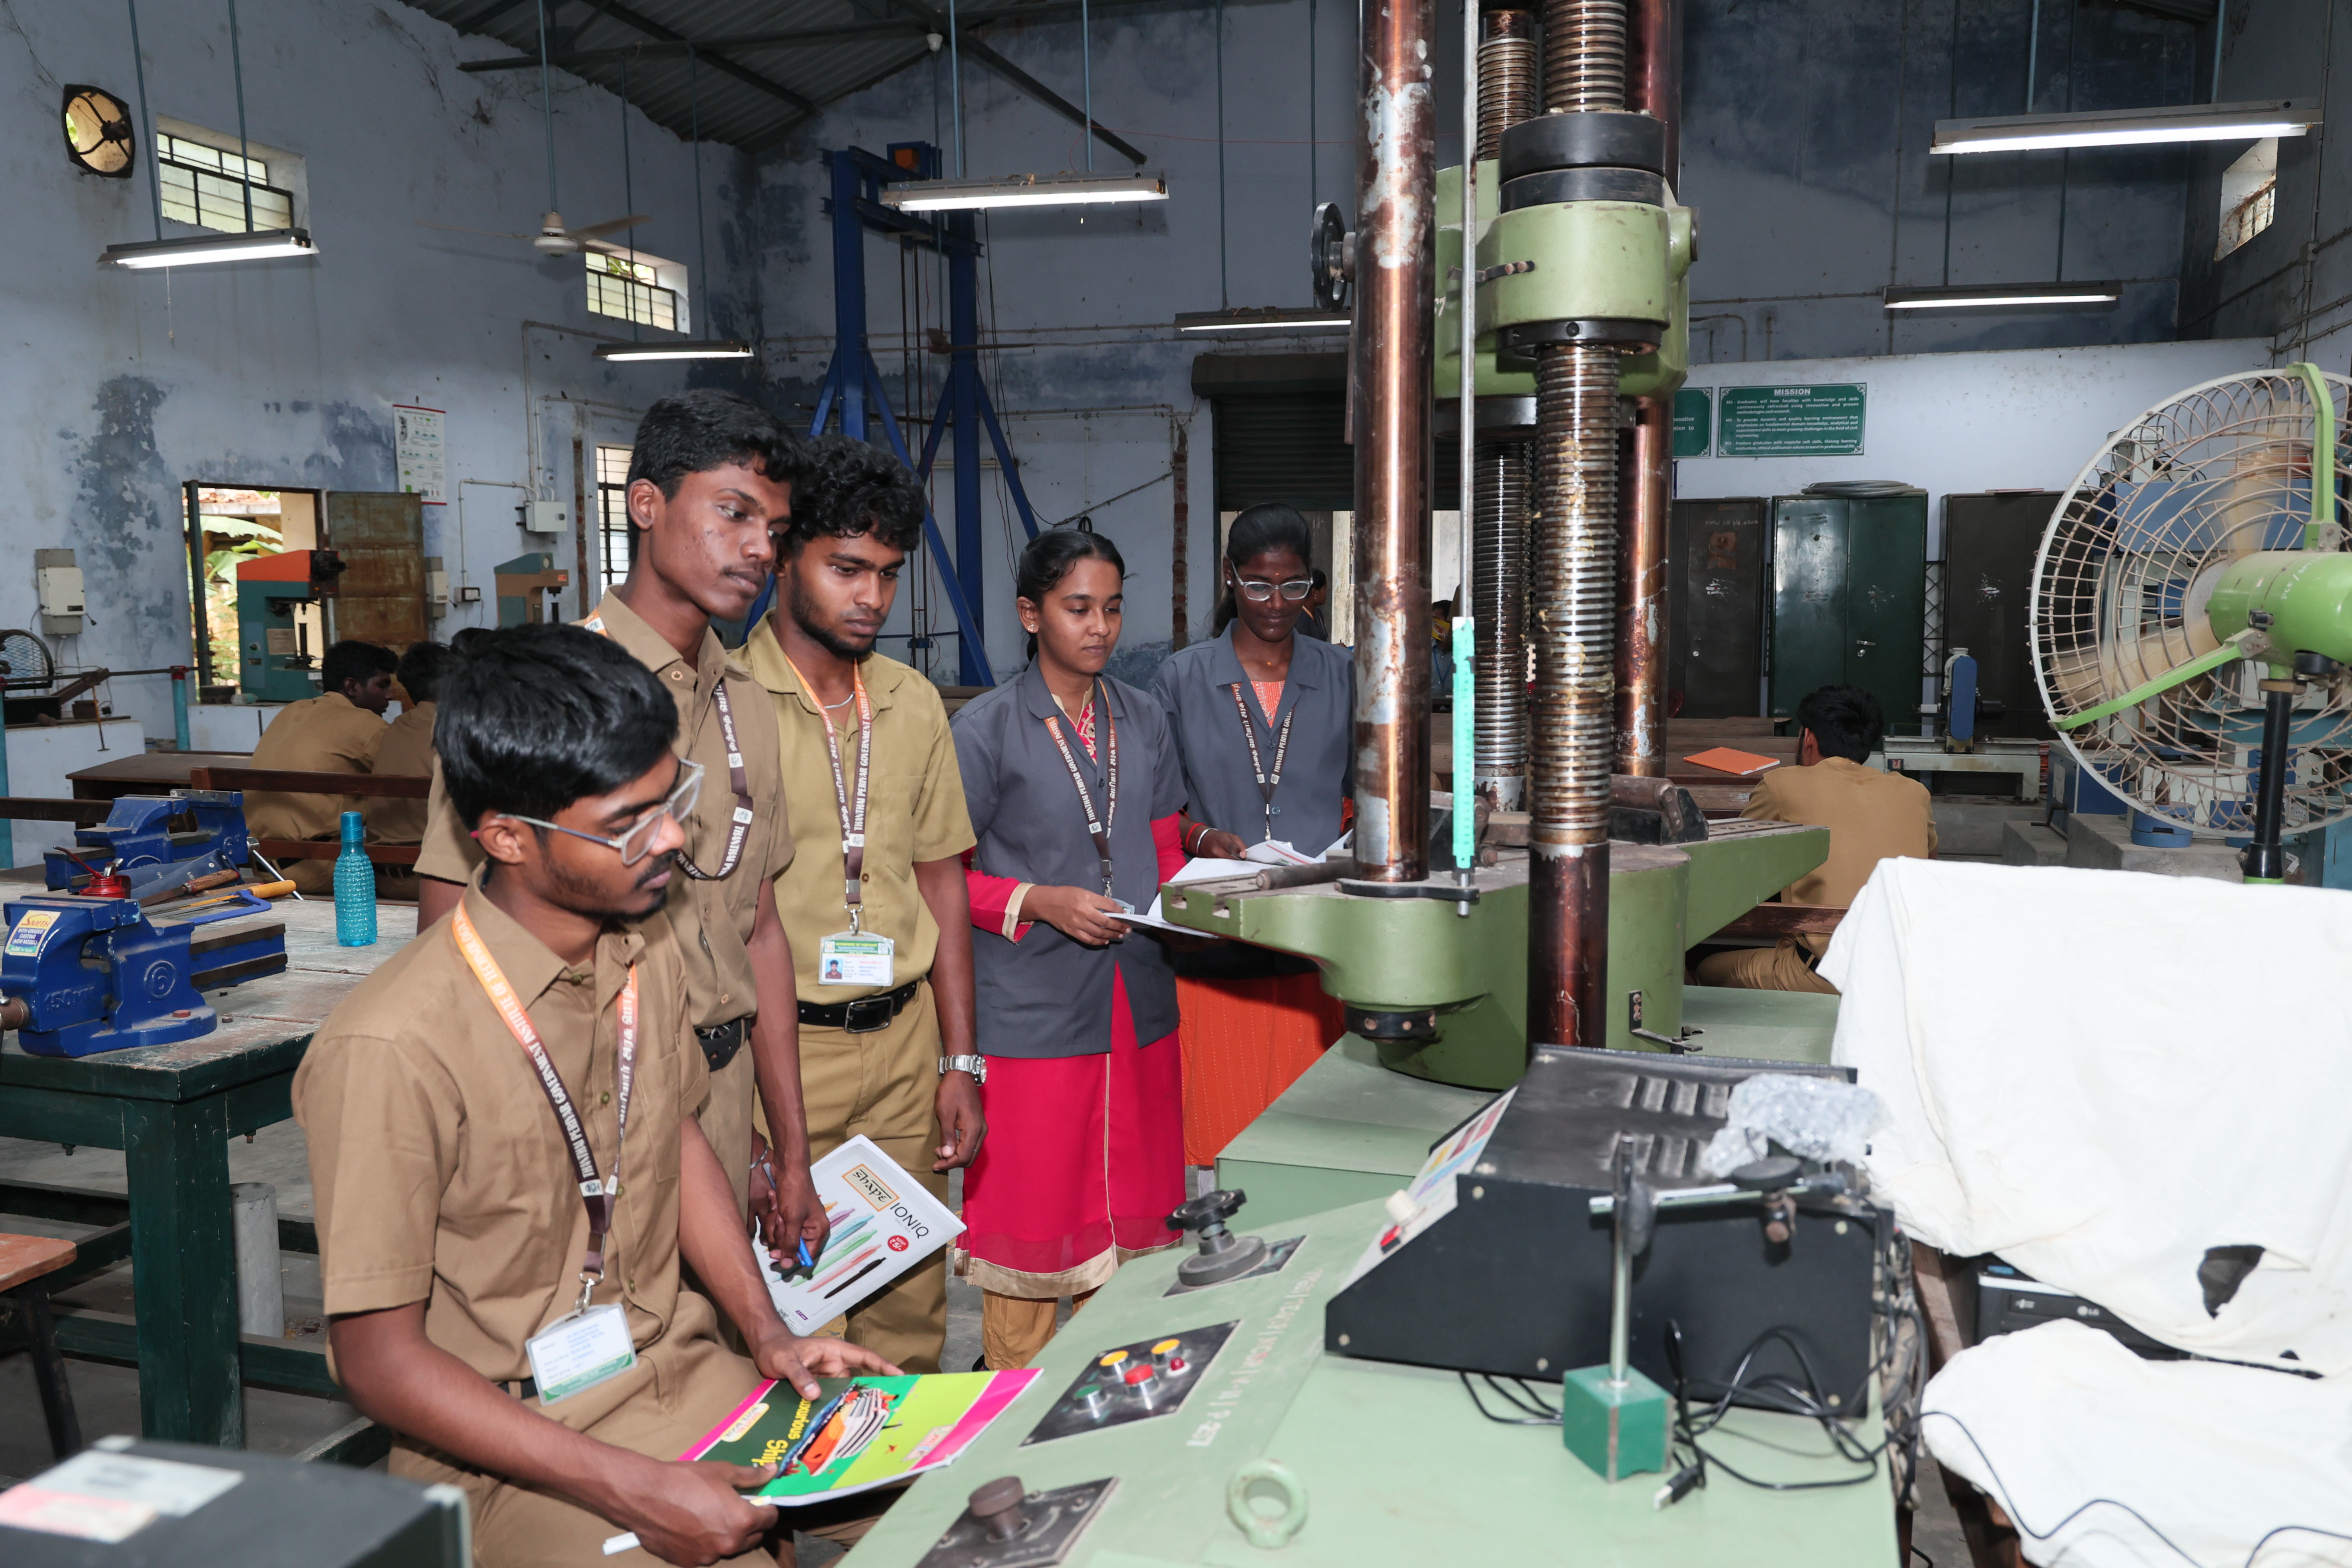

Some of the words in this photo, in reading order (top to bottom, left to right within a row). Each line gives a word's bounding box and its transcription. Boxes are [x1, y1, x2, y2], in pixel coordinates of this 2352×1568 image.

[860, 720, 871, 766] GOVERNMENT
[1242, 720, 1255, 749] பெரியார்
[1274, 749, 1284, 772] THANTHAI
[1279, 728, 1289, 749] PERIYAR
[1057, 739, 1078, 772] GOVERNMENT
[857, 767, 868, 797] PERIYAR
[1073, 772, 1087, 795] PERIYAR
[854, 798, 866, 831] THANTHAI
[1081, 794, 1096, 821] THANTHAI
[726, 825, 745, 862] THANTHAI
[21, 916, 51, 927] SMITH
[490, 981, 508, 997] OF
[499, 995, 536, 1044] INSTITUTE
[528, 1042, 567, 1104] GOVERNMENT
[559, 1102, 582, 1142] PERIYAR
[573, 1139, 595, 1179] THANTHAI
[890, 1202, 929, 1239] IONIQ
[787, 1398, 812, 1440] uxurious
